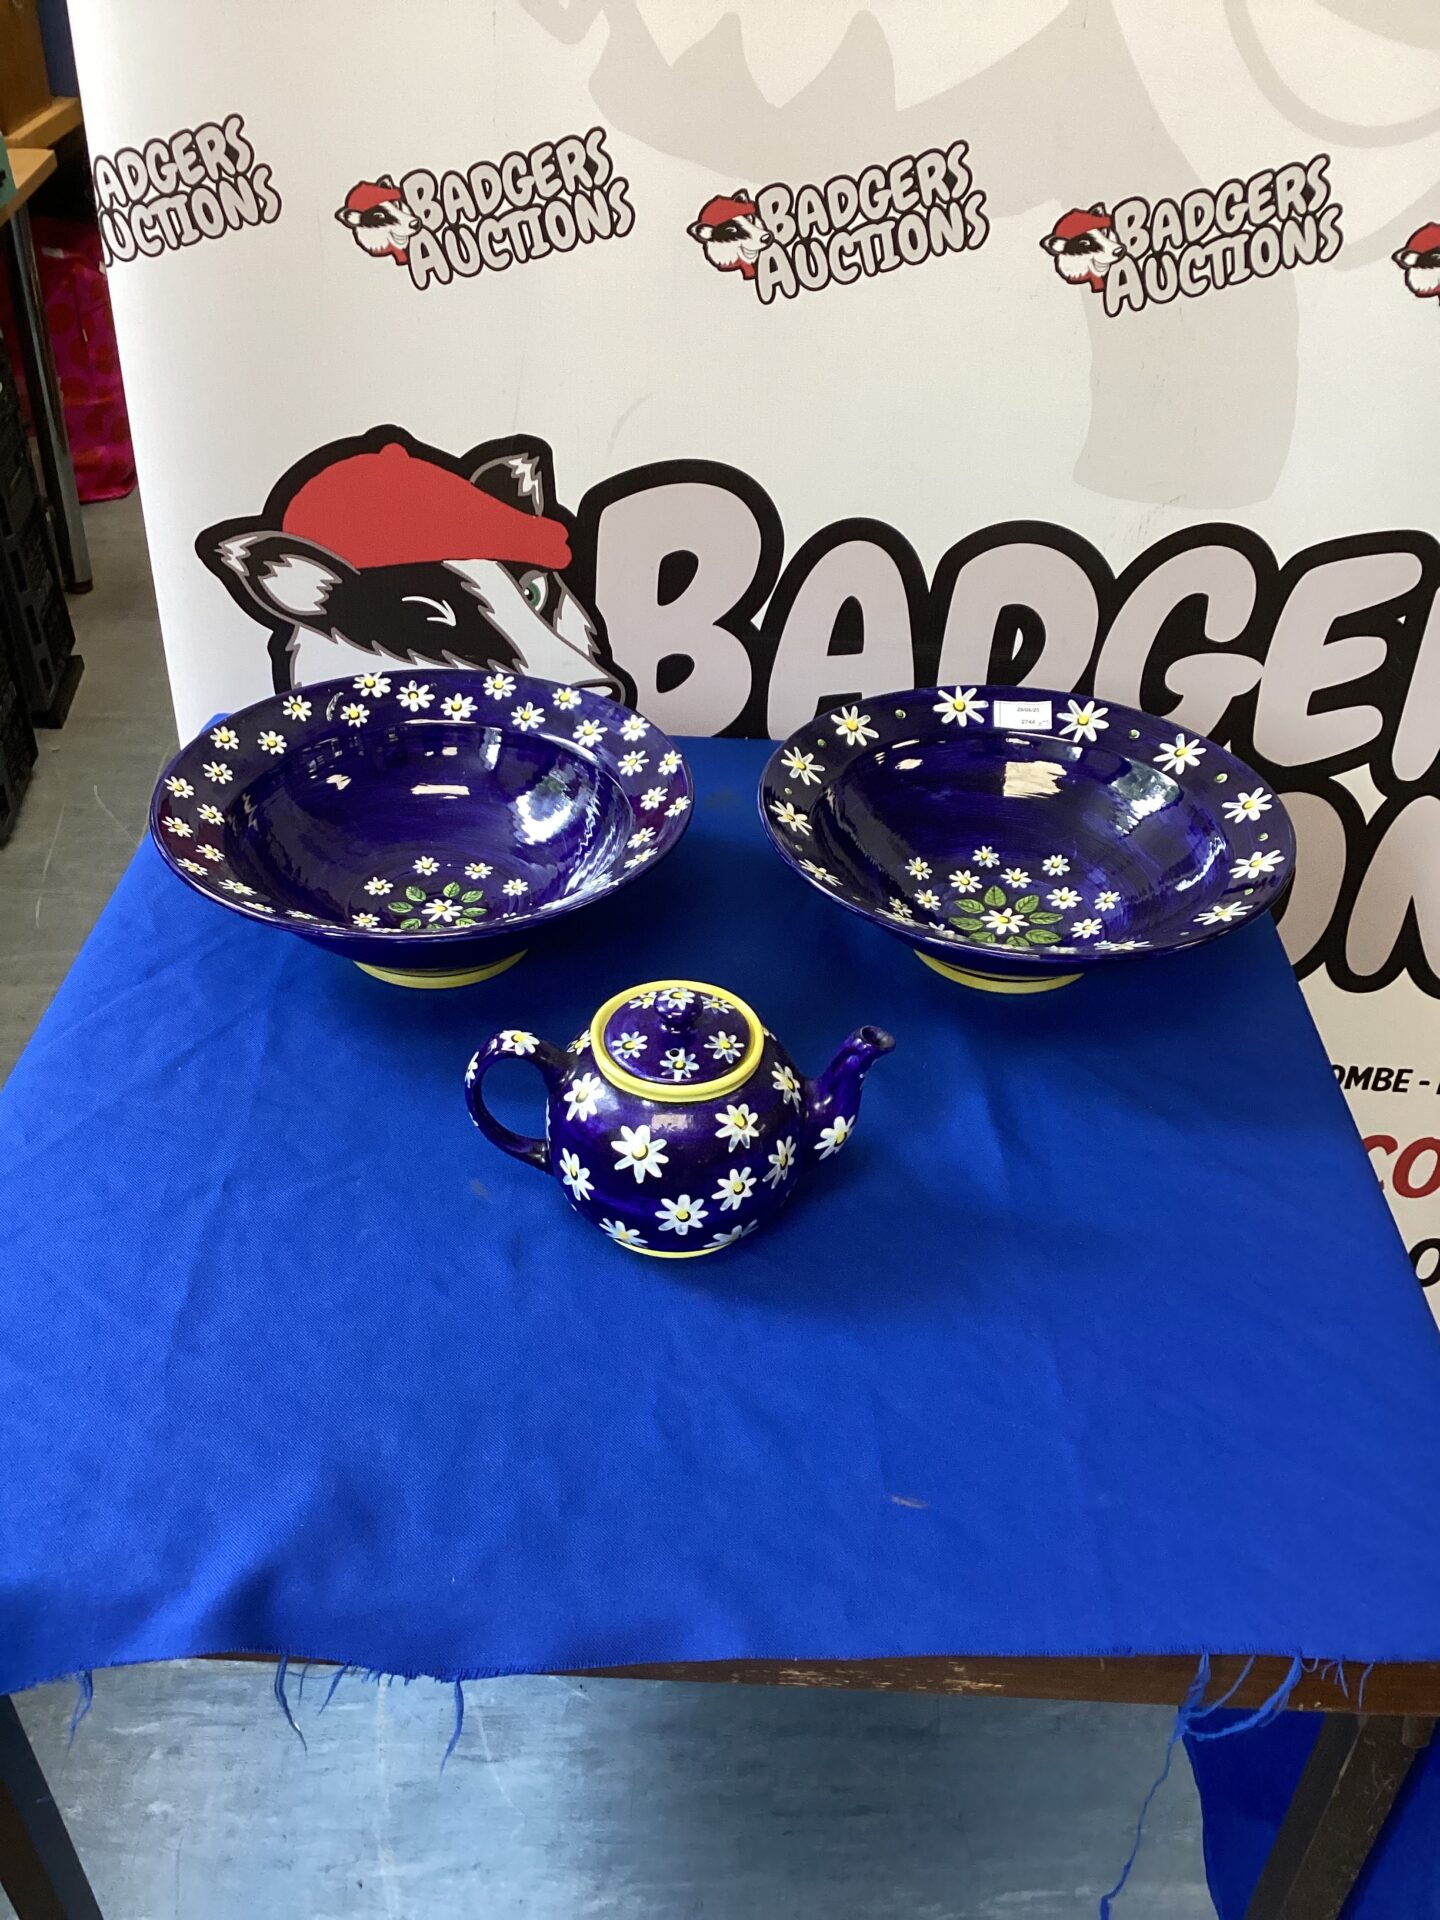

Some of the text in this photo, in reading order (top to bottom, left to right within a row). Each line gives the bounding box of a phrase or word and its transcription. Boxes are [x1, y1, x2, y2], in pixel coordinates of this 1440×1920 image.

[93, 113, 255, 210] ADGERS
[399, 126, 614, 234] BADGERS
[755, 139, 973, 248] BADGERS
[1111, 153, 1332, 261] BADGERS
[408, 176, 636, 291] AUCTIONS
[755, 190, 991, 305] AUCTIONS
[1103, 203, 1344, 318] AUCTIONS
